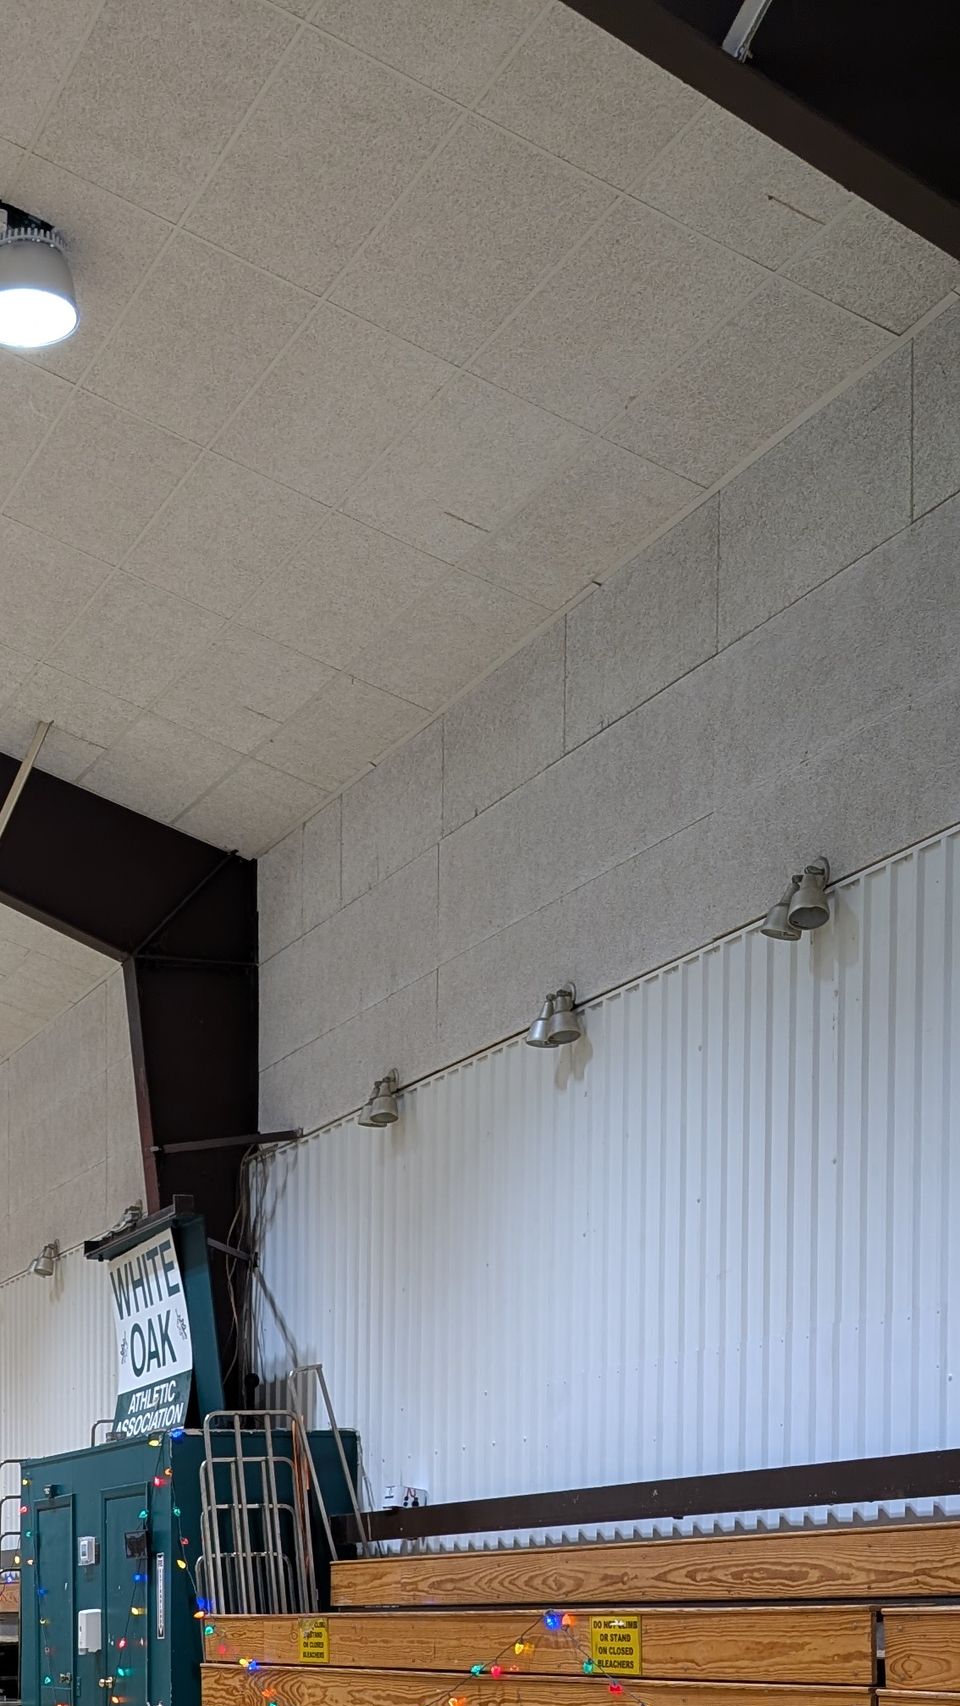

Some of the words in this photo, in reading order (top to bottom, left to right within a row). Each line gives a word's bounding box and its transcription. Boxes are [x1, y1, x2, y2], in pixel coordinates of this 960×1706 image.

[110, 1239, 181, 1320] WHITE
[130, 1309, 177, 1378] OAK
[127, 1379, 177, 1415] ATHLETIC
[115, 1402, 185, 1437] ASSOCIATION
[593, 1620, 602, 1629] DO
[599, 1633, 609, 1642] OR
[609, 1633, 632, 1642] STAND
[598, 1646, 608, 1655] ON
[608, 1646, 634, 1655] CLOSED
[597, 1659, 634, 1669] BLEACHERS
